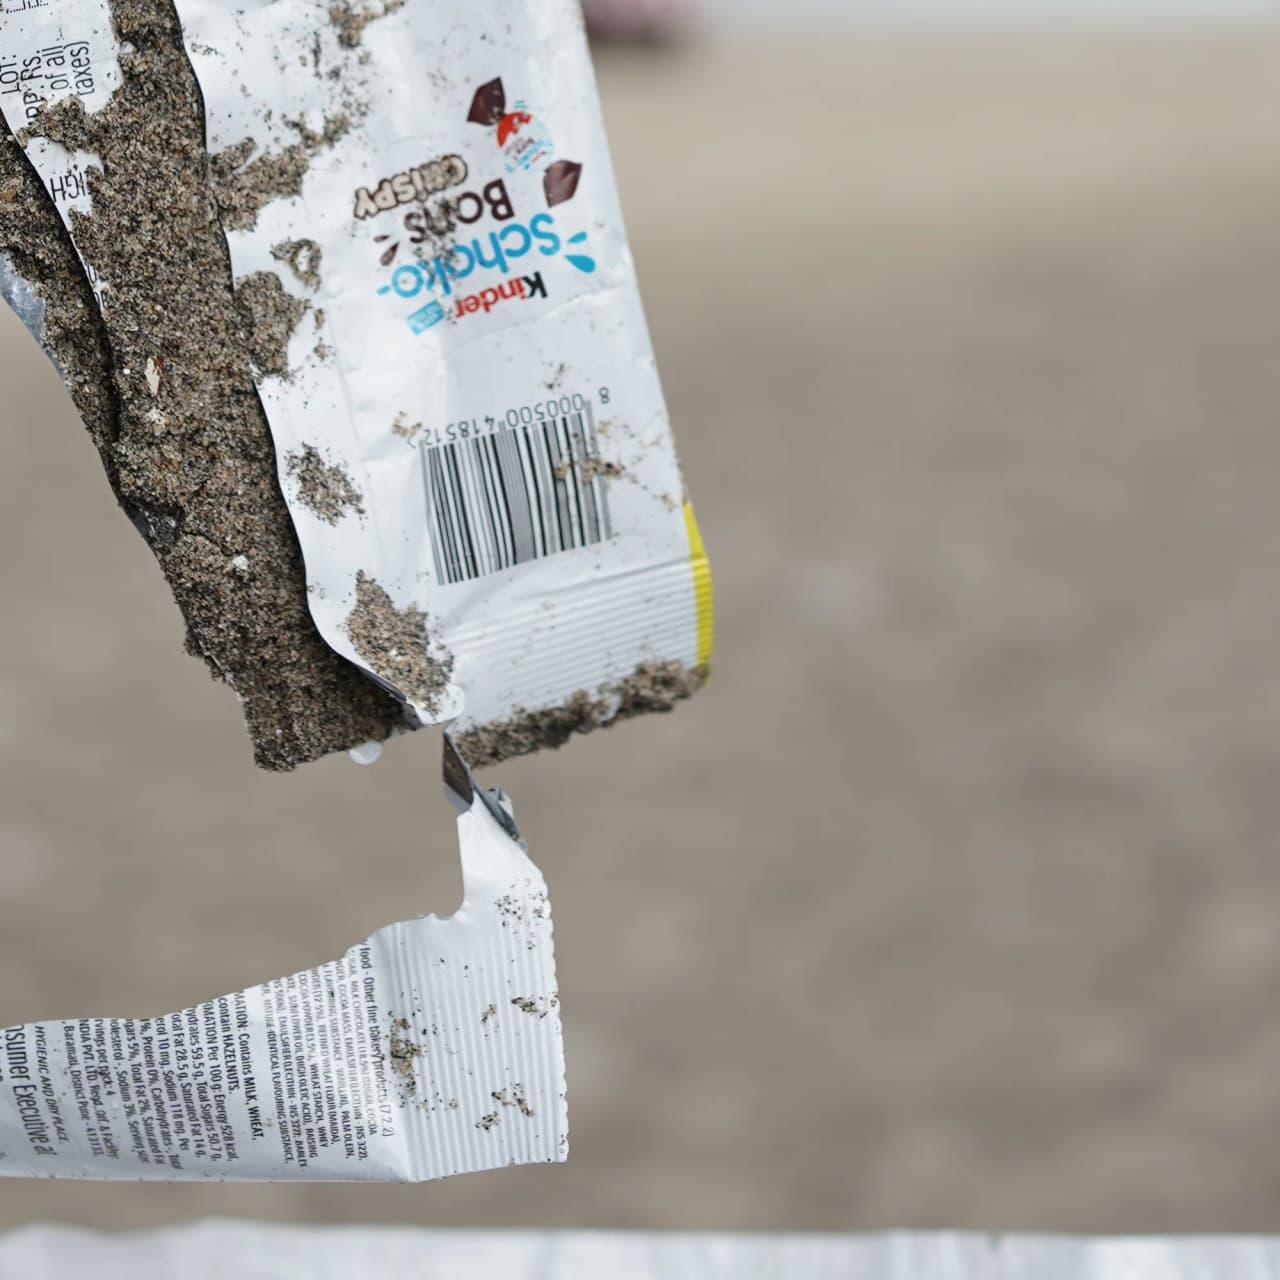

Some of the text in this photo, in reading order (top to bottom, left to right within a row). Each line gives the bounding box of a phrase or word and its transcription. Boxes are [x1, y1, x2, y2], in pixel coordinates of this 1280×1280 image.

[21, 51, 42, 80] Rs.
[42, 46, 69, 90] of all
[64, 41, 94, 96] taxes)
[404, 178, 515, 244] Bons
[422, 387, 610, 446] 8 000500 418512
[360, 948, 372, 969] food
[298, 974, 308, 1000] COCOA
[338, 984, 348, 1010] COCOA
[351, 981, 359, 999] MILK
[364, 978, 376, 1002] Other
[171, 1012, 186, 1031] otal
[288, 996, 302, 1041] SUNFLOWER
[301, 1001, 313, 1033] POWDER
[352, 1000, 366, 1046] CHOCOLATE
[368, 1006, 378, 1023] fine
[79, 1020, 92, 1042] NDIA
[155, 1018, 168, 1036] erol
[34, 1026, 48, 1074] HYGIENIC
[142, 1036, 156, 1067] Protein
[158, 1038, 169, 1049] 10
[173, 1033, 185, 1047] Fat
[218, 998, 239, 1094] contain HAZELNUTS.
[295, 1042, 304, 1053] OIL
[369, 1026, 384, 1058] bakery
[82, 1045, 95, 1063] PVT.
[97, 1049, 108, 1063] per
[128, 1043, 139, 1062] 5%,
[176, 1048, 188, 1070] 28.5
[191, 1047, 204, 1069] 59.5
[208, 1046, 219, 1061] Per
[239, 1034, 253, 1075] Contains
[64, 1026, 90, 1120] Baramati, District Pune
[85, 1066, 99, 1083] LTD.
[99, 1066, 114, 1089] pack:
[130, 1063, 144, 1083] Total
[148, 1070, 159, 1086] 0%,
[210, 1064, 223, 1082] 100
[310, 1064, 320, 1089] WHEAT
[318, 1024, 328, 1056] REFINED
[326, 1086, 336, 1110] FLOUR
[330, 1018, 342, 1060] SUBSTANCE
[341, 1111, 350, 1132] PALM
[40, 1076, 54, 1096] AND
[135, 1085, 147, 1097] Fat
[162, 1070, 177, 1101] Sodium
[196, 1082, 210, 1102] Total
[244, 1077, 258, 1105] MILK,
[279, 1016, 292, 1062] EMULSIFIER
[289, 1105, 298, 1118] INS
[295, 1139, 307, 1167] BARLEY
[298, 1078, 310, 1101] OLEIC
[372, 1060, 387, 1103] products
[46, 1098, 60, 1115] DRY
[138, 1099, 151, 1115] 2%,
[180, 1082, 199, 1122] Saturated
[272, 1072, 285, 1119] FLAVOURING
[12, 1084, 50, 1143] Executive
[33, 1146, 57, 1155] at
[117, 1070, 132, 1102] Sodium
[128, 1120, 145, 1148] Serving
[151, 1088, 173, 1146] Carbohydrates
[171, 1104, 184, 1119] 118
[199, 1103, 216, 1131] Sugars
[214, 1094, 228, 1123] Energy
[190, 1123, 203, 1136] Fat
[220, 1125, 234, 1141] 528
[248, 1106, 264, 1140] WHEAT,
[367, 1108, 378, 1135] COCOA
[142, 1116, 162, 1153] Saturated
[178, 1138, 190, 1150] Per
[194, 1138, 205, 1148] 14
[208, 1134, 222, 1151] 50.7
[305, 1128, 318, 1158] RAISING
[318, 1126, 328, 1147] WHEY
[154, 1154, 166, 1165] Fat
[168, 1154, 184, 1170] Total
